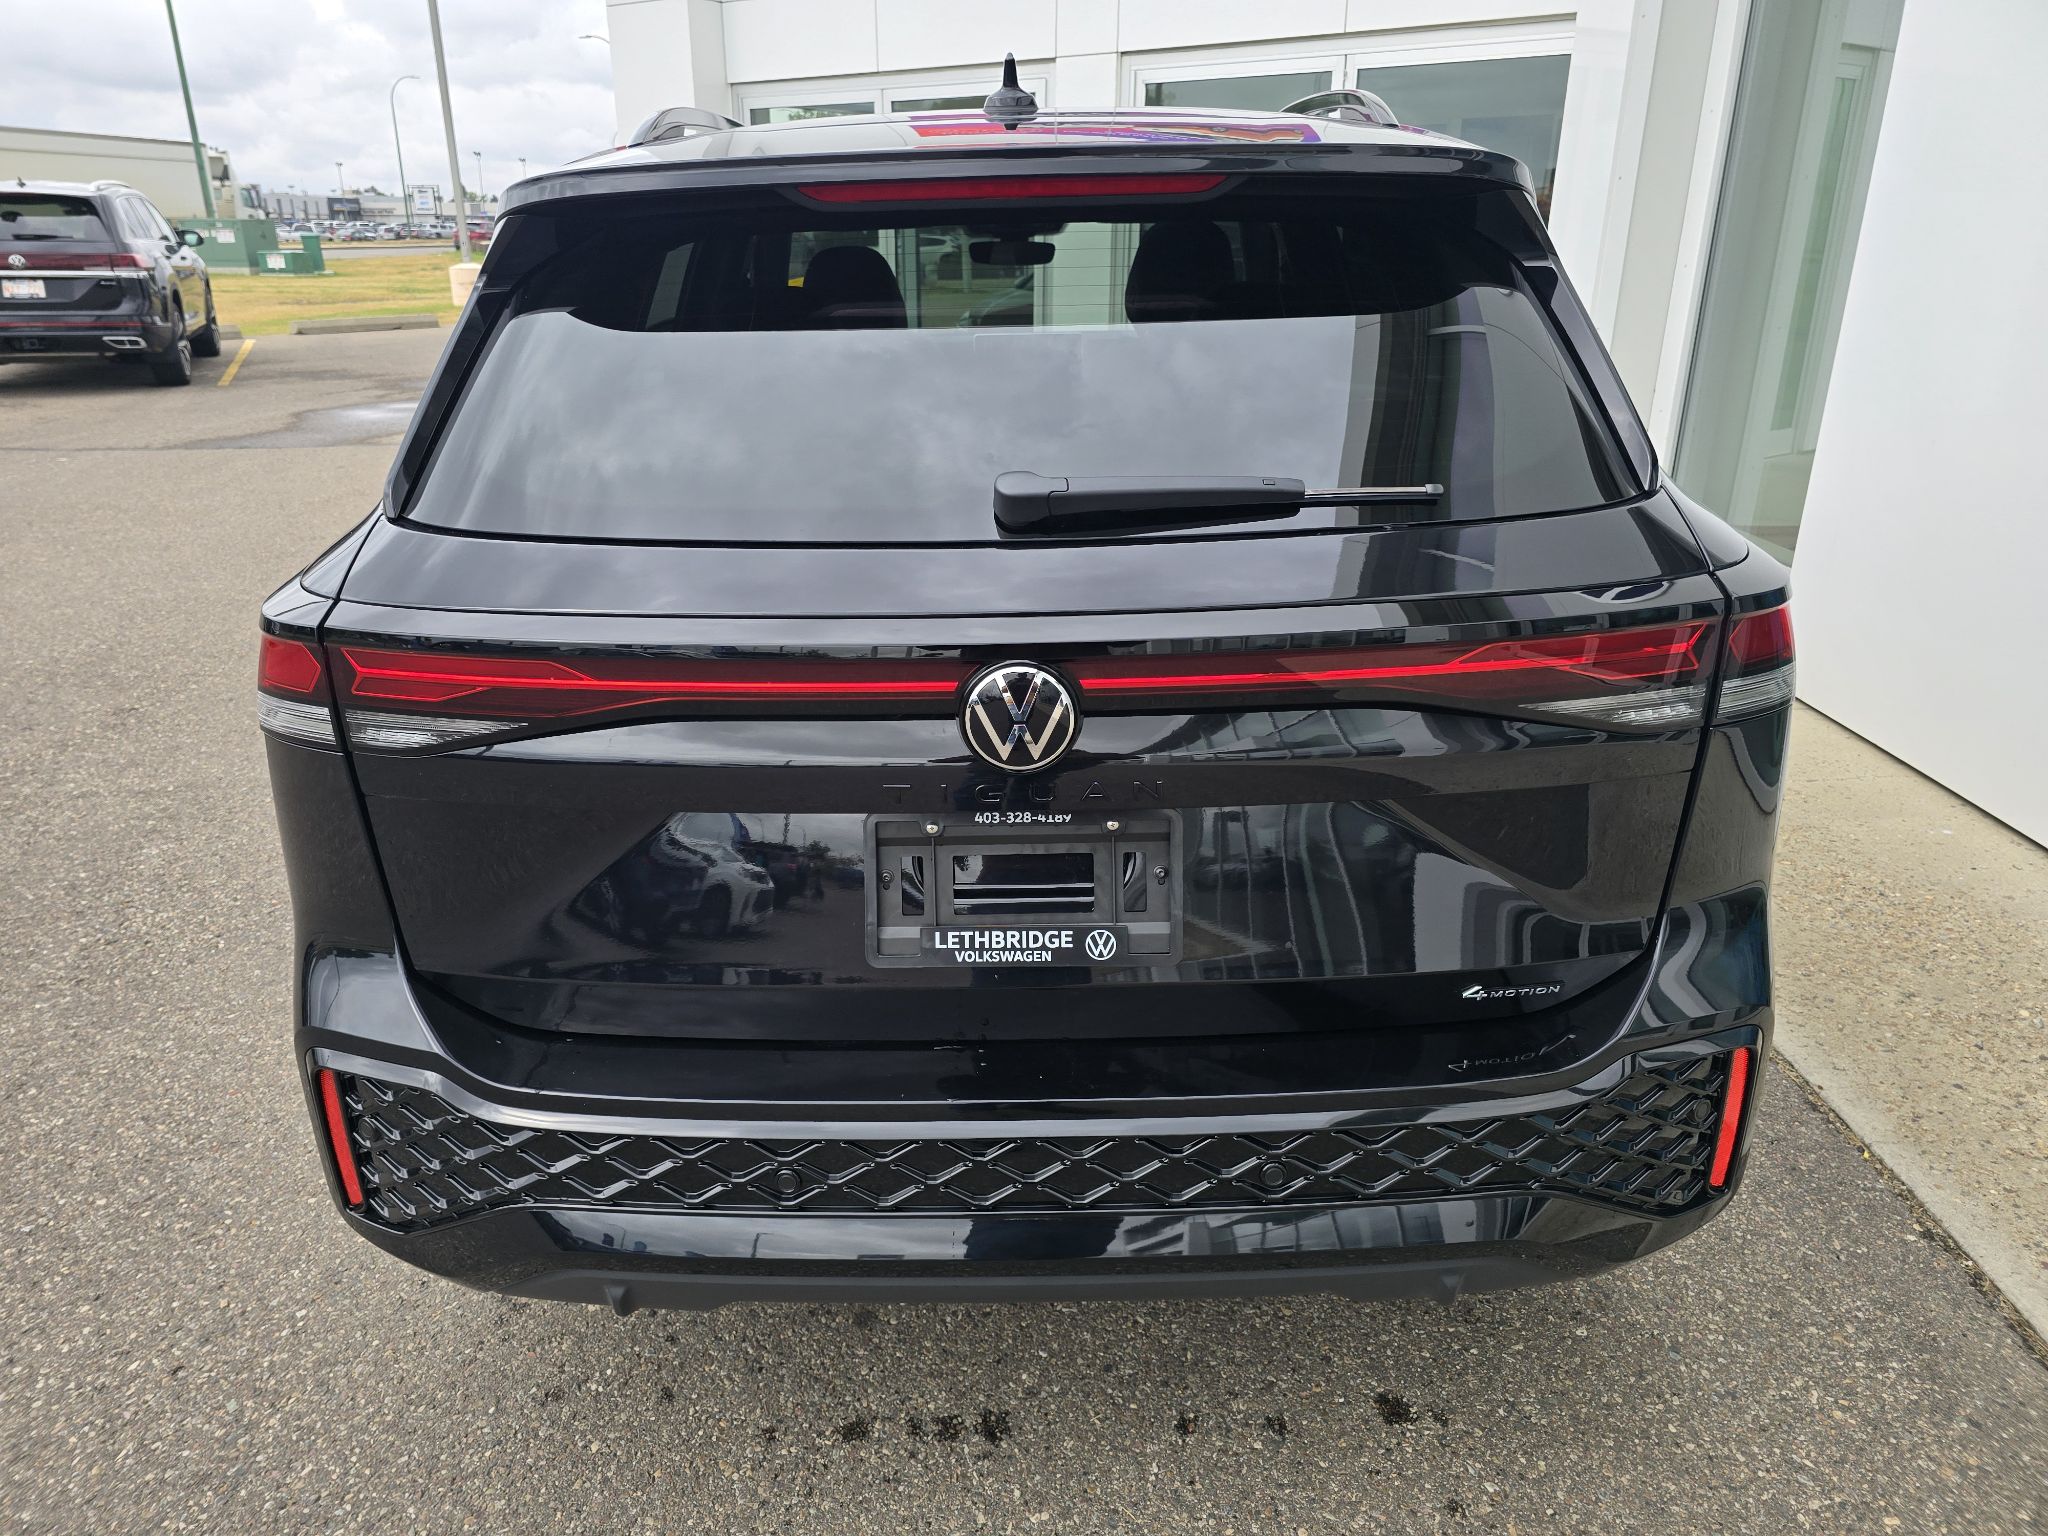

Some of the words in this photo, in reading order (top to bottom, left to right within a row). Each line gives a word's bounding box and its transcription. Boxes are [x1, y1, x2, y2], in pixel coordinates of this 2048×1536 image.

[883, 781, 1165, 802] TIGUAN
[934, 930, 1074, 949] LETHBRIDGE
[954, 950, 1052, 963] VOLKSWAGEN
[1462, 985, 1561, 1001] 4MOTION
